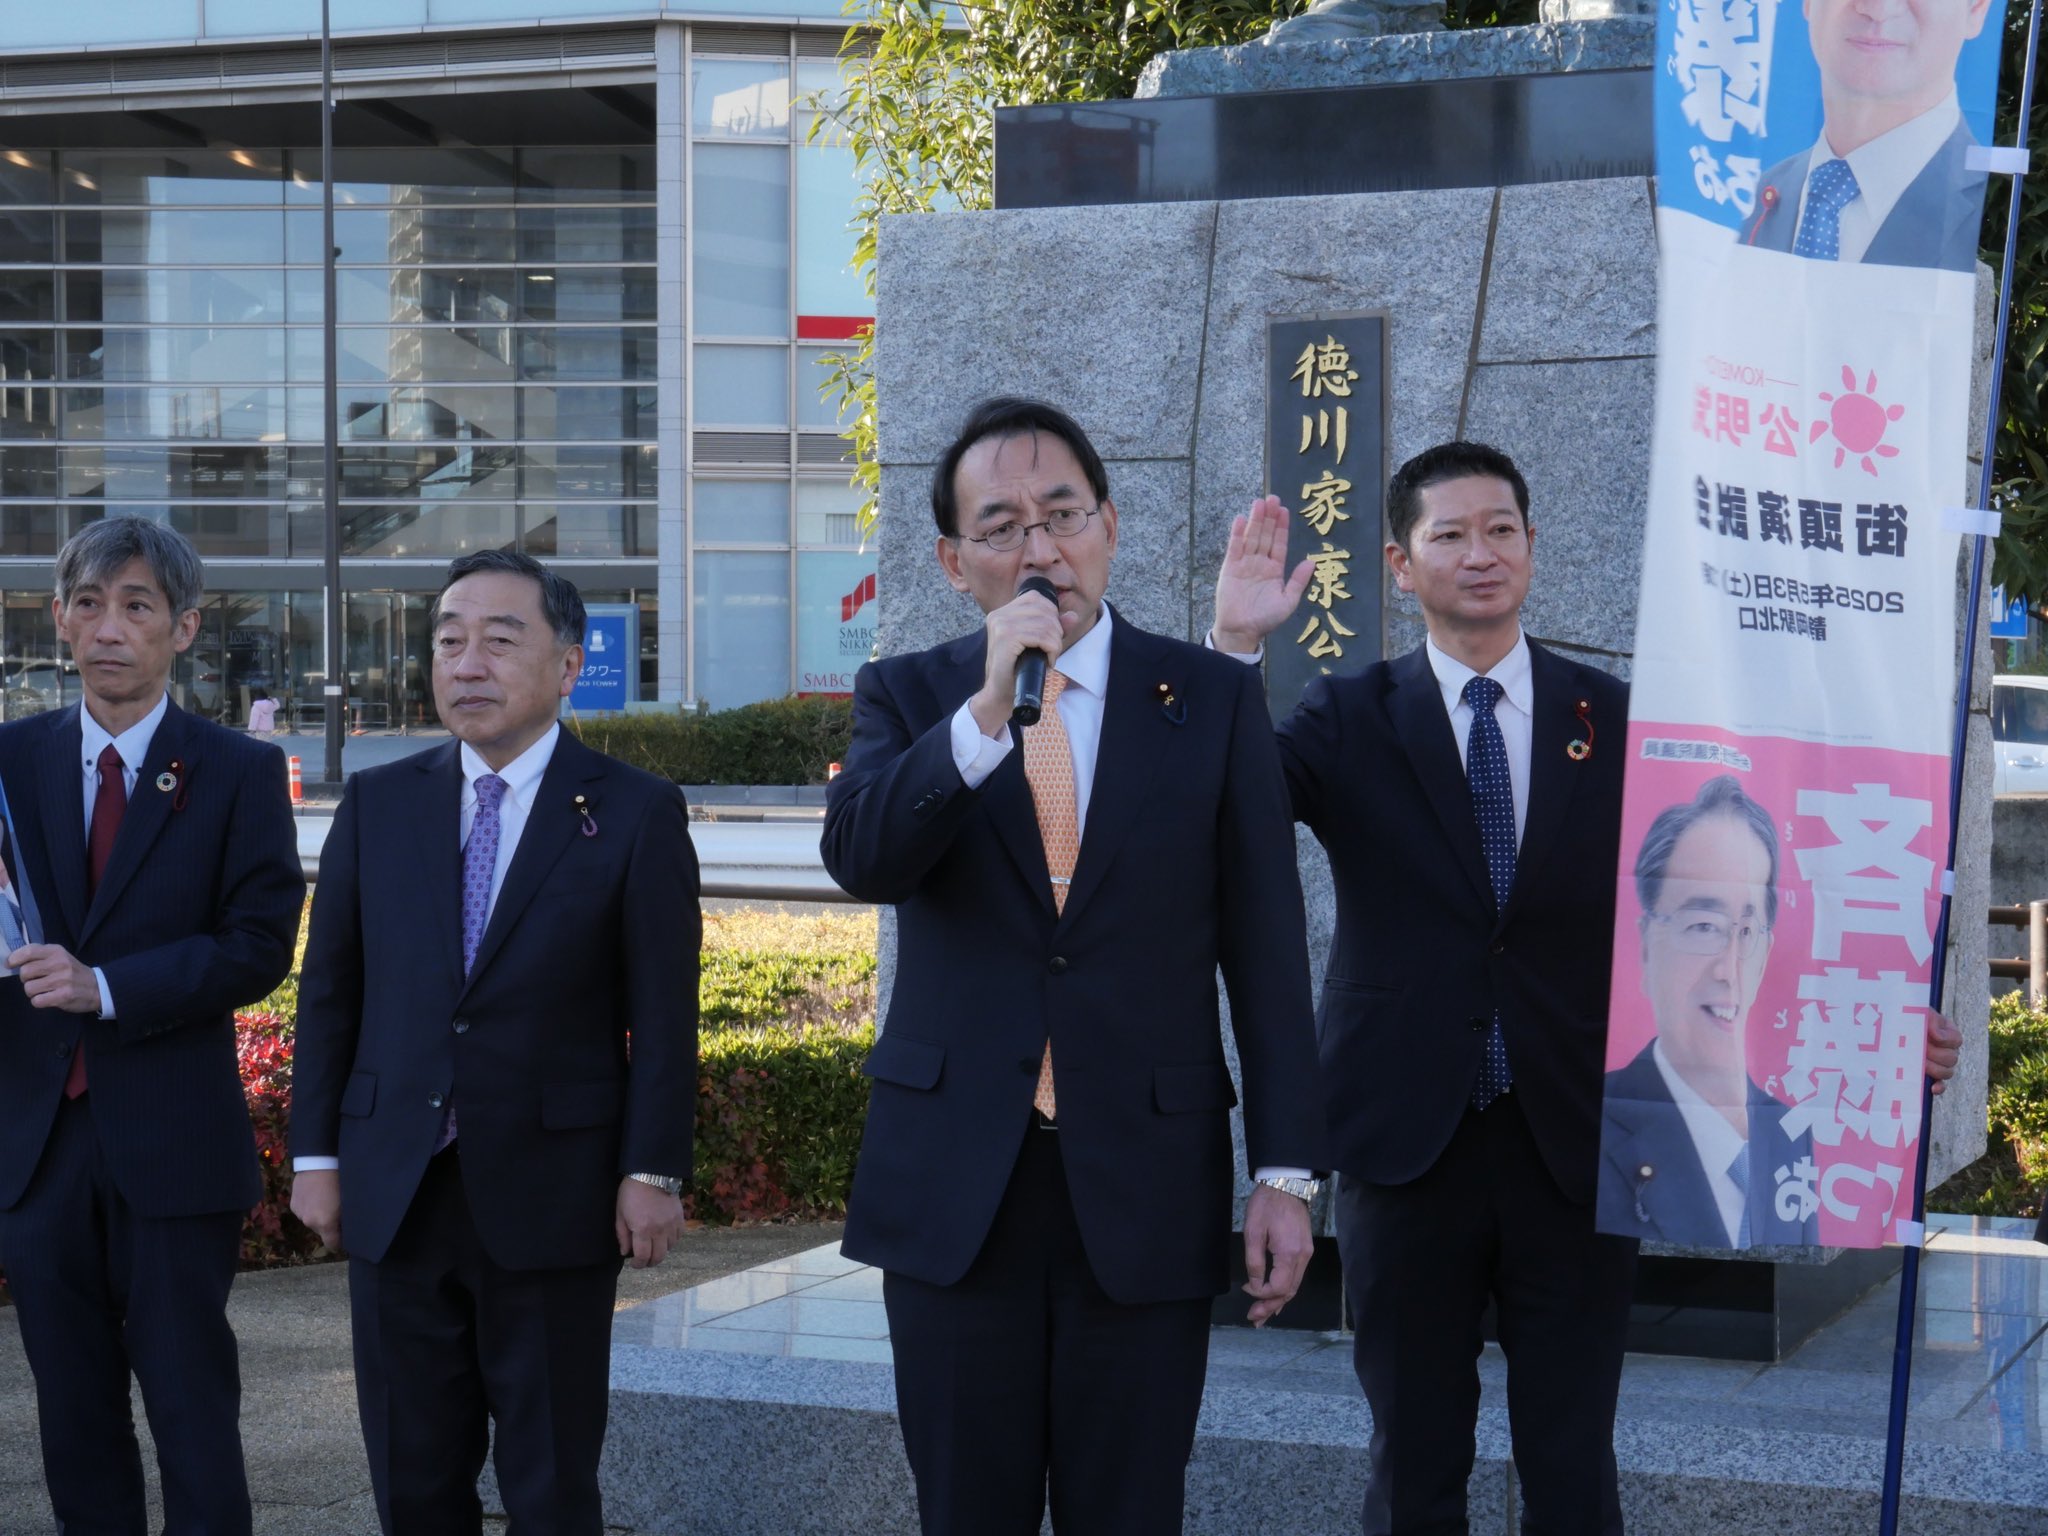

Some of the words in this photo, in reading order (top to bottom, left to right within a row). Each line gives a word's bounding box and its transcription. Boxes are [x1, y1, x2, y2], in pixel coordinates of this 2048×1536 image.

[1290, 334, 1359, 676] 徳川家康公
[839, 627, 880, 639] SMBC
[804, 673, 851, 687] SMBC
